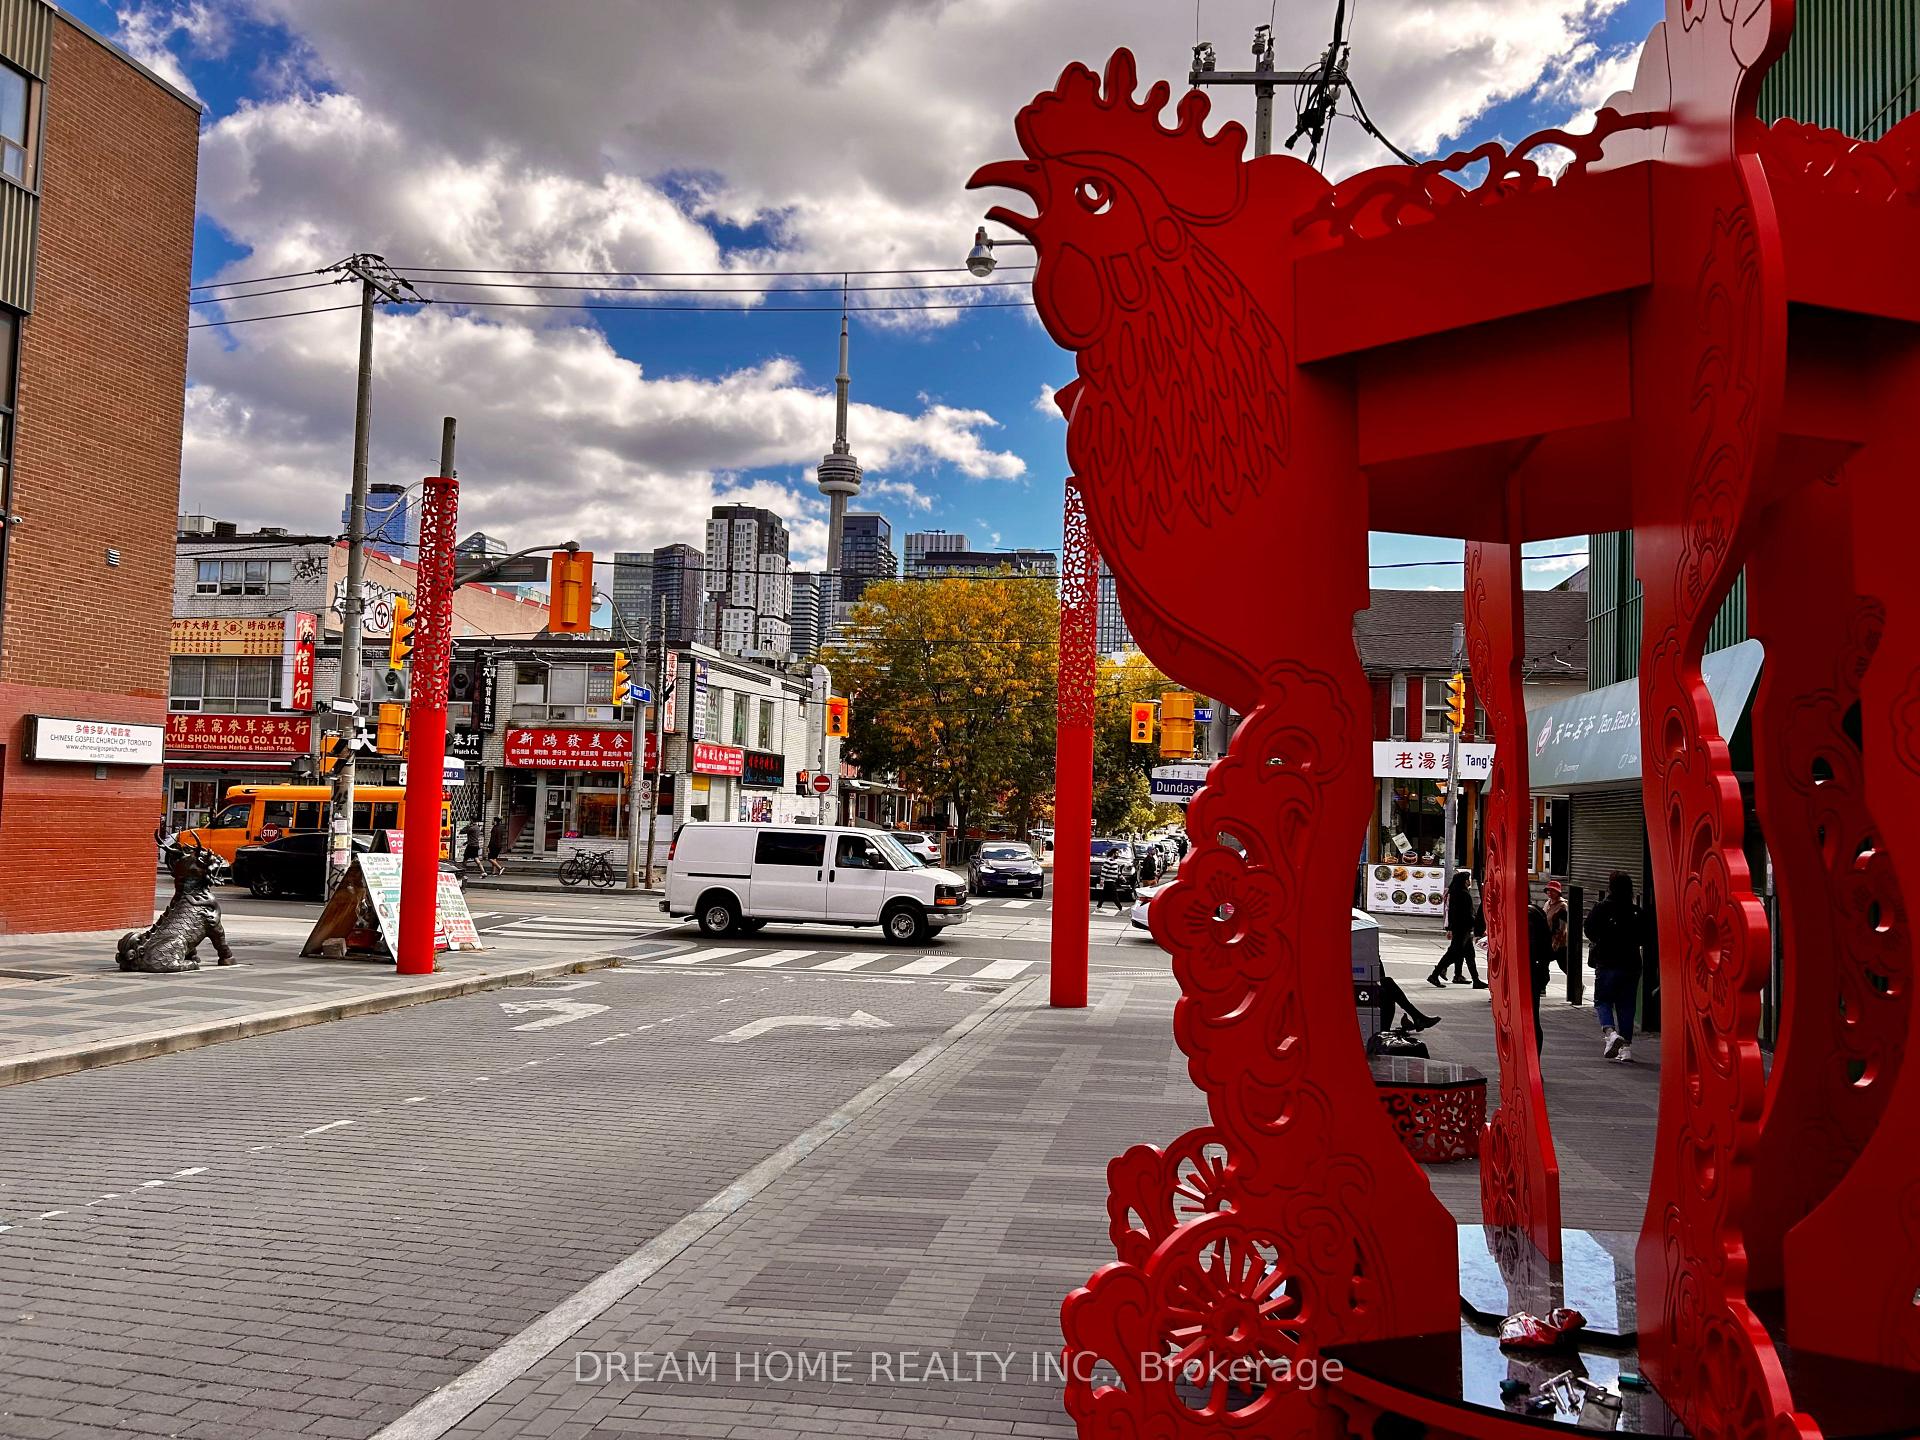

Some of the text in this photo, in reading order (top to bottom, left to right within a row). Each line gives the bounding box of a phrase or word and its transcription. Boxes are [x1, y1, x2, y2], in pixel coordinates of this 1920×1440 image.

[166, 714, 310, 735] 信燕窩參茸海味行
[1597, 713, 1613, 734] Ten
[1611, 705, 1637, 731] Ren's
[50, 734, 73, 742] CHINESE
[96, 737, 118, 745] CHURCH
[127, 739, 152, 747] TORONTO
[188, 734, 217, 742] SHON
[220, 735, 250, 744] HONG
[252, 736, 270, 744] CO.
[273, 737, 295, 745] LTD.
[518, 731, 650, 749] 新鴻發美食
[602, 760, 648, 768] RESTAT
[1465, 754, 1495, 769] Tang's
[1156, 781, 1195, 793] Dundas
[263, 829, 278, 838] STOP
